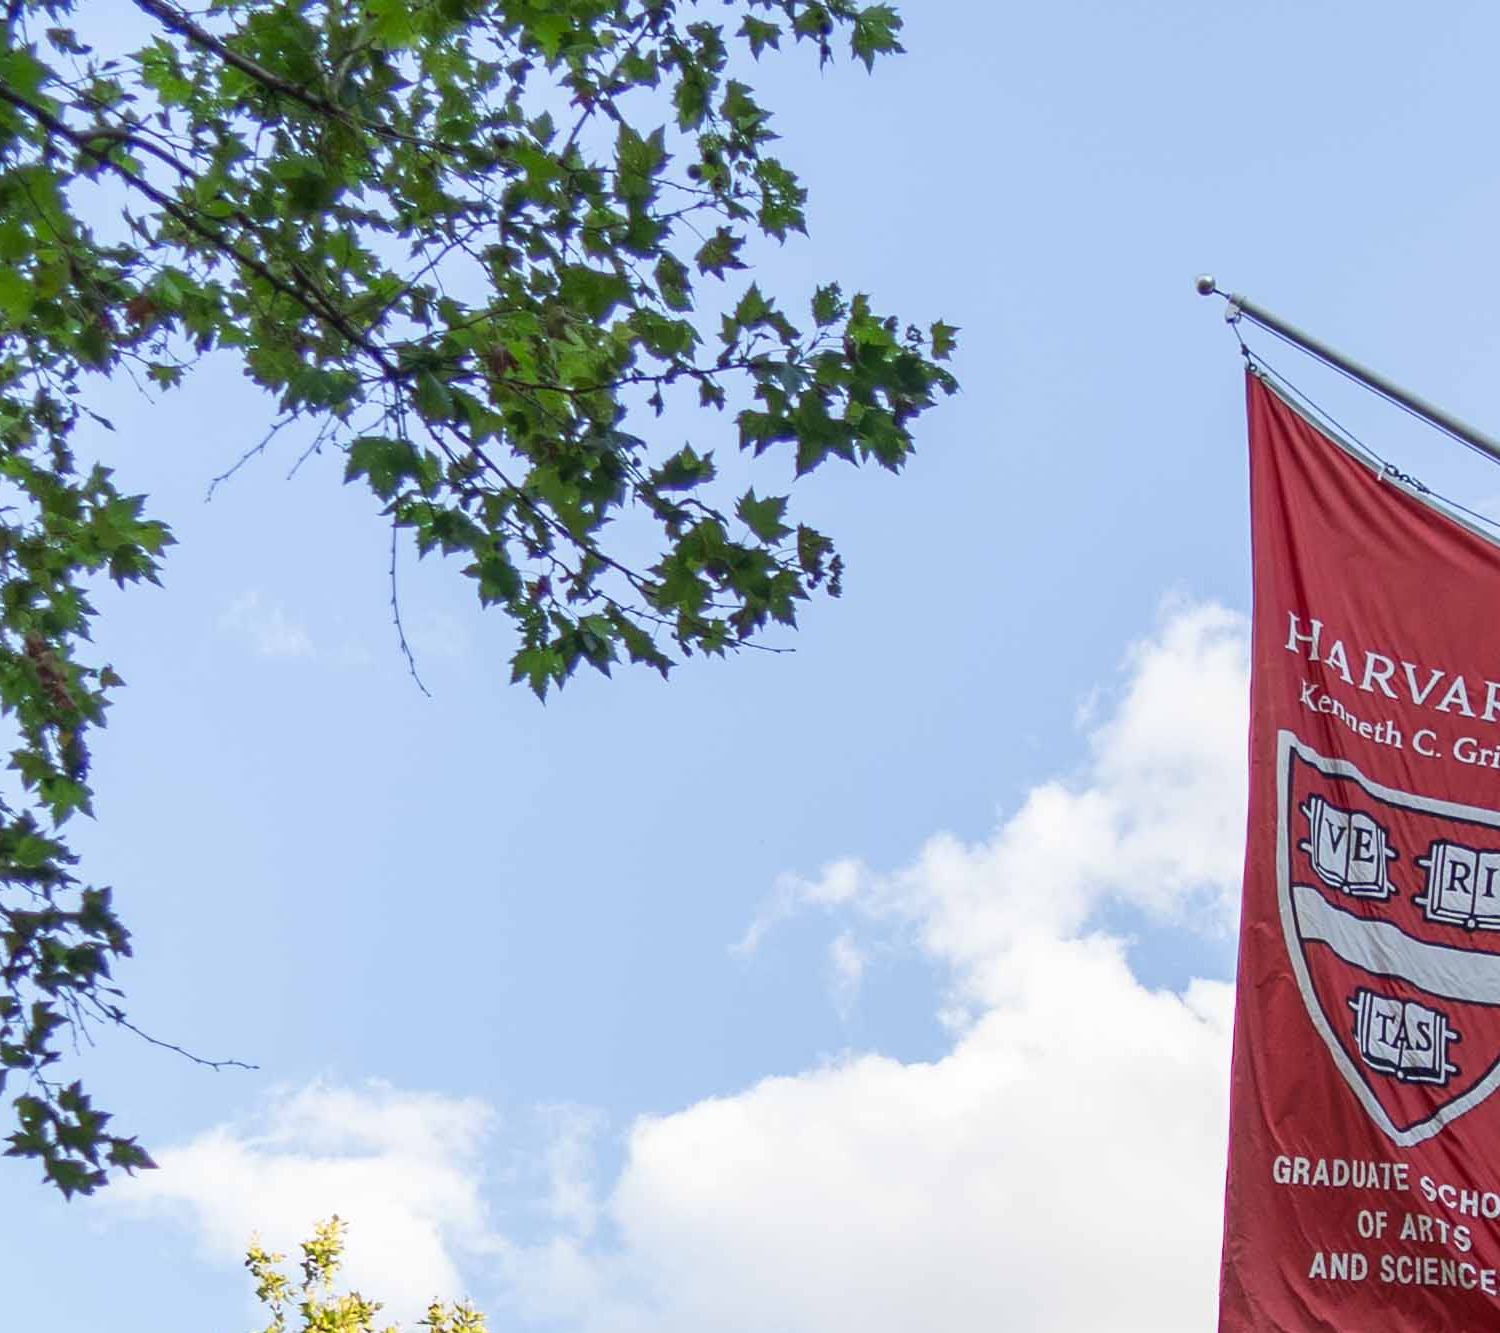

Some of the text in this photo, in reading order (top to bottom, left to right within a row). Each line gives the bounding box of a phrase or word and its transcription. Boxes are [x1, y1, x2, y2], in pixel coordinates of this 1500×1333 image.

[1299, 679, 1403, 749] Kenneth
[1411, 730, 1442, 758] C.
[1324, 818, 1375, 863] VE
[1446, 862, 1496, 898] RI
[1374, 1014, 1432, 1051] TAS
[1273, 1155, 1409, 1191] GRADUATE
[1357, 1210, 1472, 1251] OF ARTS
[1308, 1253, 1367, 1282] AND
